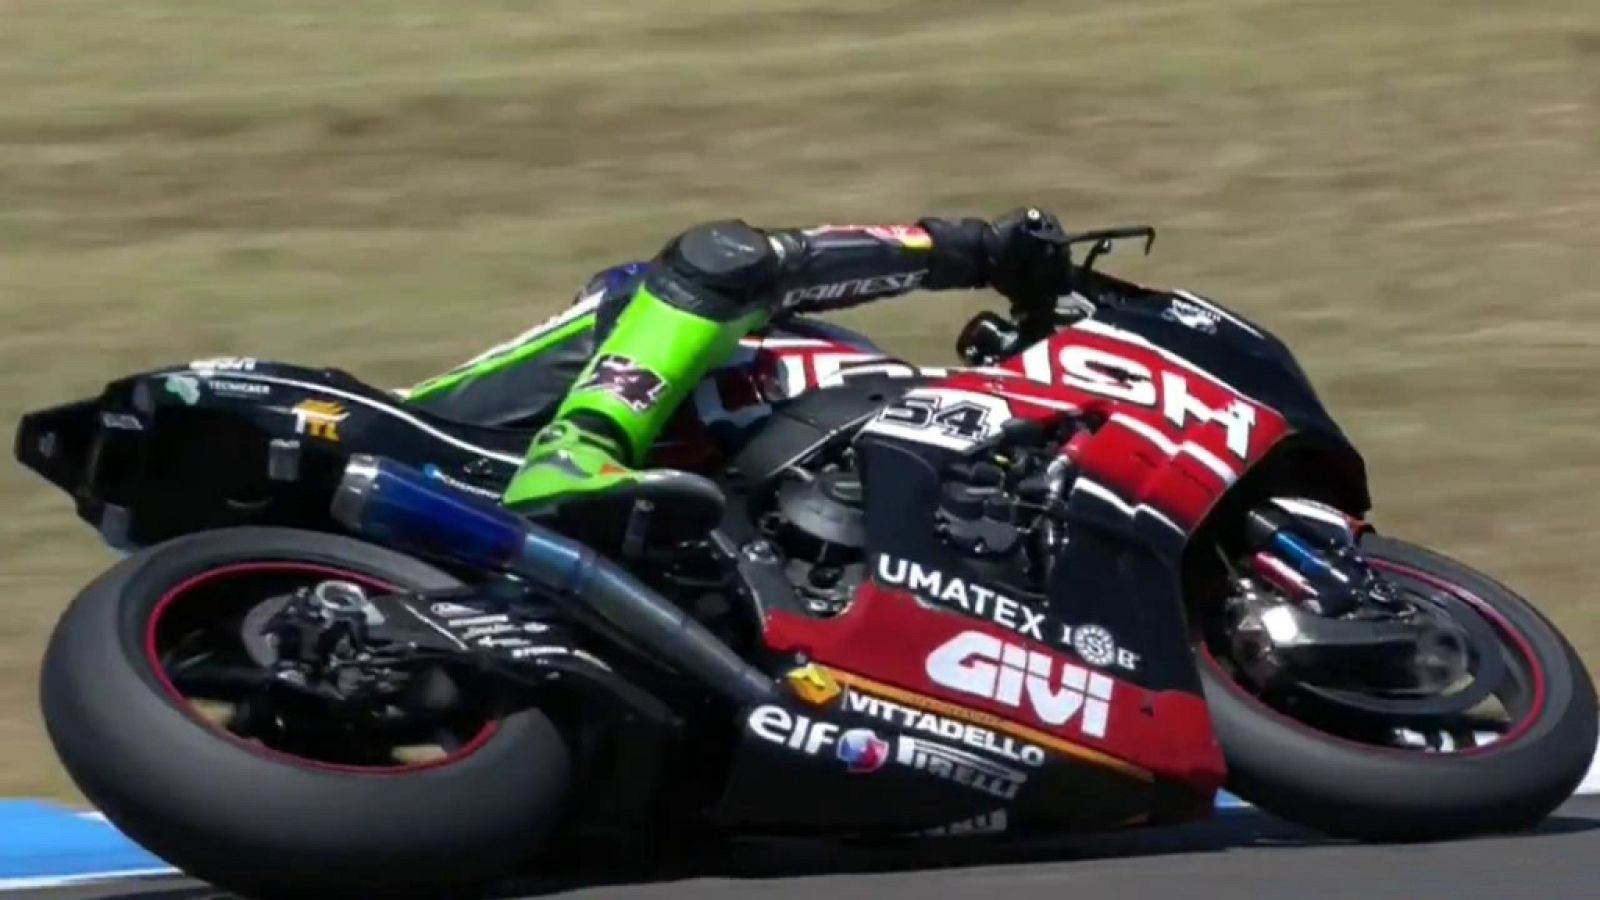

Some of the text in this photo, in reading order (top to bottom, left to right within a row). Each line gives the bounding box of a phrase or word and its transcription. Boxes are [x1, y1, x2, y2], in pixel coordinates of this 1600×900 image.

[879, 395, 992, 443] 54
[879, 554, 1044, 642] UMATEX
[925, 629, 1114, 738] GIVI
[748, 704, 840, 755] elf
[848, 689, 1046, 768] VITTADELLO
[896, 735, 1028, 800] PIRELLI
